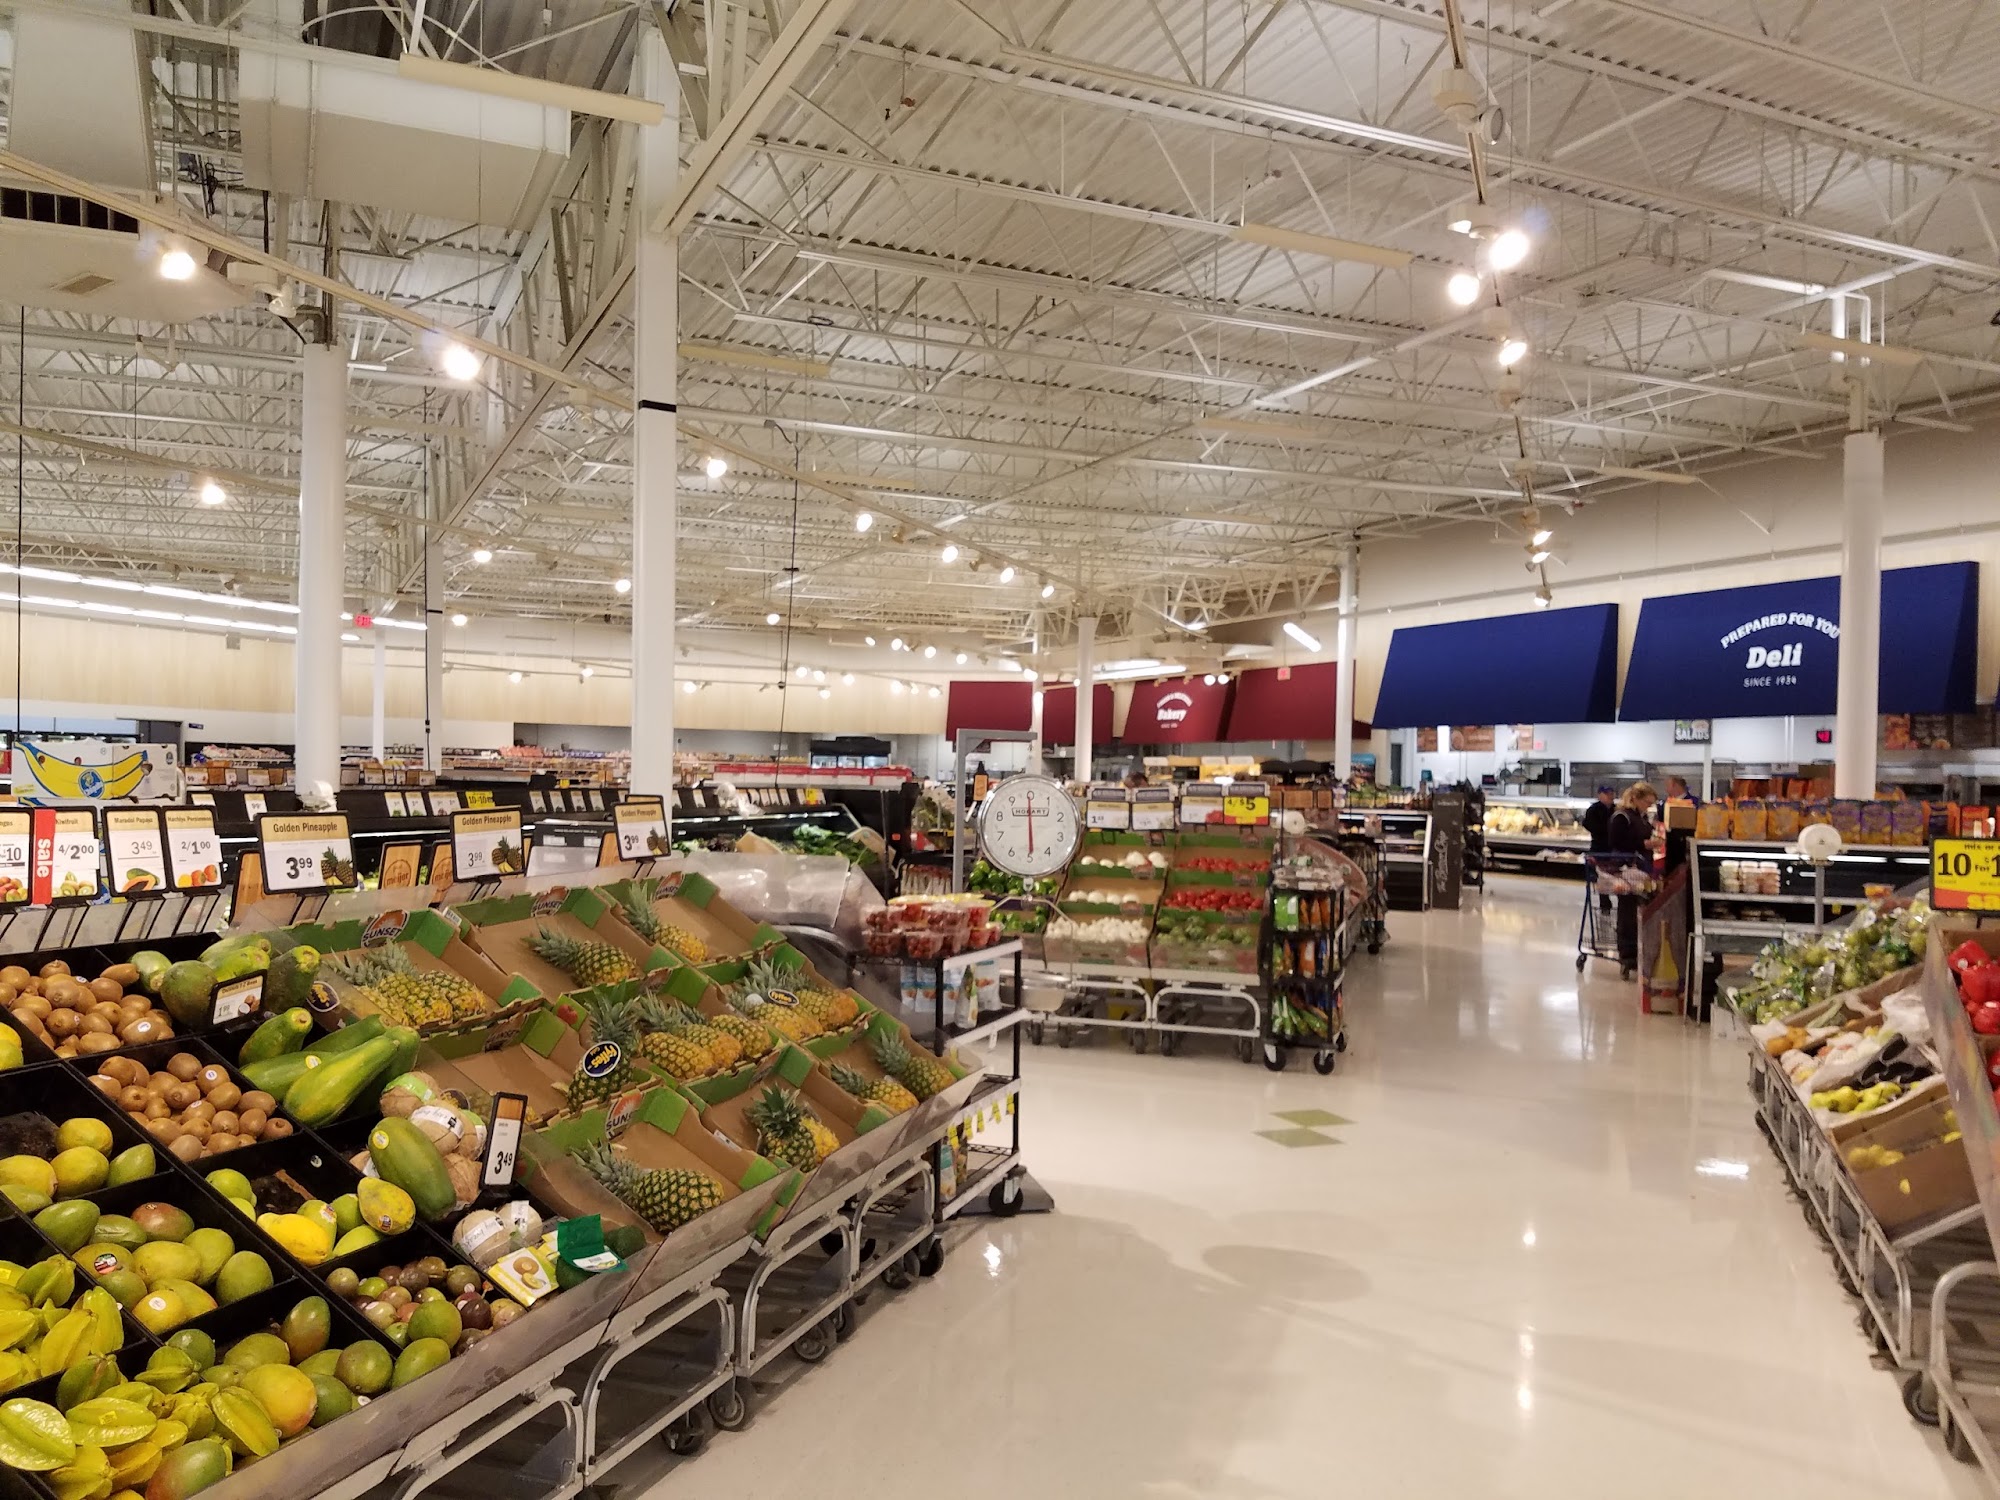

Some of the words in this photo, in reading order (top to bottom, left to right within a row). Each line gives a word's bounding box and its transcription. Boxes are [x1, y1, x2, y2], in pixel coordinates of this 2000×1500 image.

[1720, 613, 1787, 649] PREPARED
[1788, 612, 1815, 627] FOR
[1816, 617, 1840, 639] YOU
[1746, 642, 1803, 669] Deli
[1743, 676, 1771, 688] SINCE
[1008, 796, 1016, 806] 9
[1027, 791, 1035, 801] 0
[1046, 796, 1051, 807] 1
[462, 817, 483, 826] Golden
[484, 815, 513, 824] Pineapple
[996, 811, 1004, 822] 8
[1056, 812, 1065, 823] 2
[273, 823, 301, 833] Golden
[302, 821, 338, 833] Pineapple
[997, 831, 1004, 842] 7
[1056, 832, 1065, 843] 3
[1008, 848, 1016, 858] 6
[1044, 847, 1052, 857] 4
[37, 838, 53, 878] sale
[1027, 853, 1034, 863] 5
[1938, 852, 1972, 876] 10
[533, 901, 562, 912] SUNSET
[363, 927, 401, 940] SUNSET
